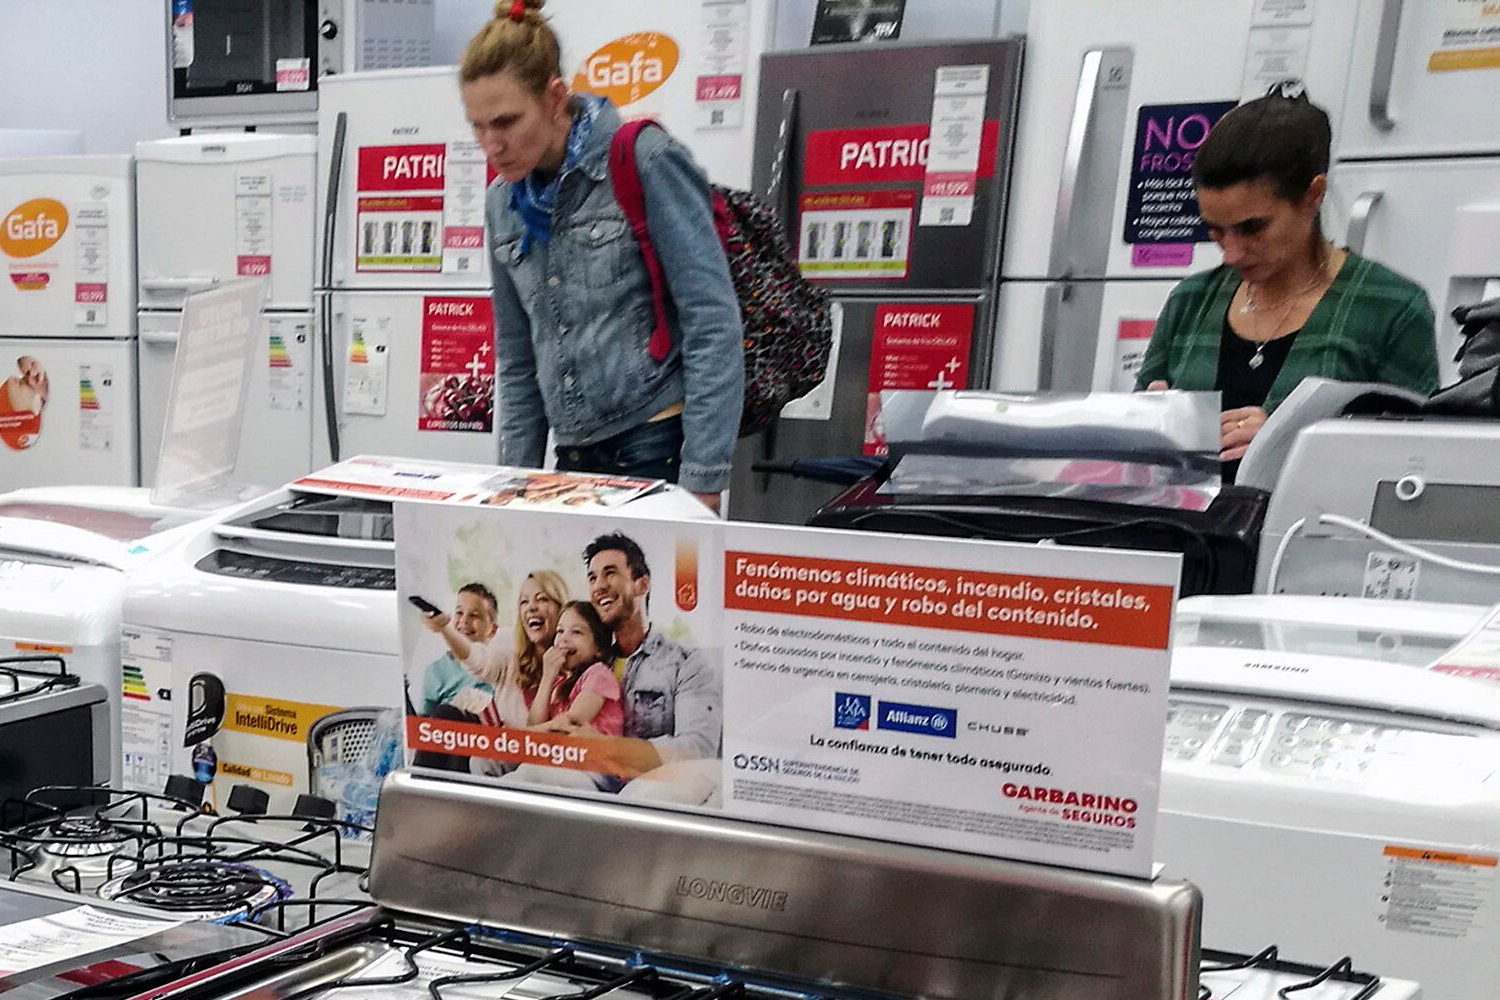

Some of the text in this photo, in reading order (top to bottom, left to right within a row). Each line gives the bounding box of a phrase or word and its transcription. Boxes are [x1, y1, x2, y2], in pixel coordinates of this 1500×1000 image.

[587, 51, 663, 88] Gafa
[1144, 113, 1211, 151] NO
[383, 154, 445, 180] PATRI
[840, 138, 929, 170] PATRIC
[1140, 151, 1194, 173] FROS
[7, 212, 59, 240] Gafa
[428, 303, 474, 316] PATRICK
[883, 312, 942, 328] PATRICK
[735, 558, 1151, 612] Fenómenos climáticos, incendio, cristales,
[735, 579, 1100, 630] daños por agua y robo del contenido.
[740, 622, 765, 635] Robo
[767, 625, 779, 636] de
[881, 637, 906, 649] todo
[918, 642, 970, 656] contenido
[973, 646, 989, 658] del
[820, 650, 837, 662] por
[839, 650, 881, 666] incendio
[778, 664, 791, 673] de
[837, 671, 849, 681] en
[235, 711, 298, 736] IntelliDrive
[265, 704, 297, 719] Sistema
[886, 709, 930, 727] Allianz
[418, 722, 588, 764] Seguro de hogar
[810, 734, 1053, 778] La confianza de tener todo asegurado.
[222, 763, 251, 778] Calidad
[1001, 782, 1138, 813] GARBARINO
[1062, 808, 1137, 829] SEGUROS
[676, 875, 789, 912] LONGVIE
